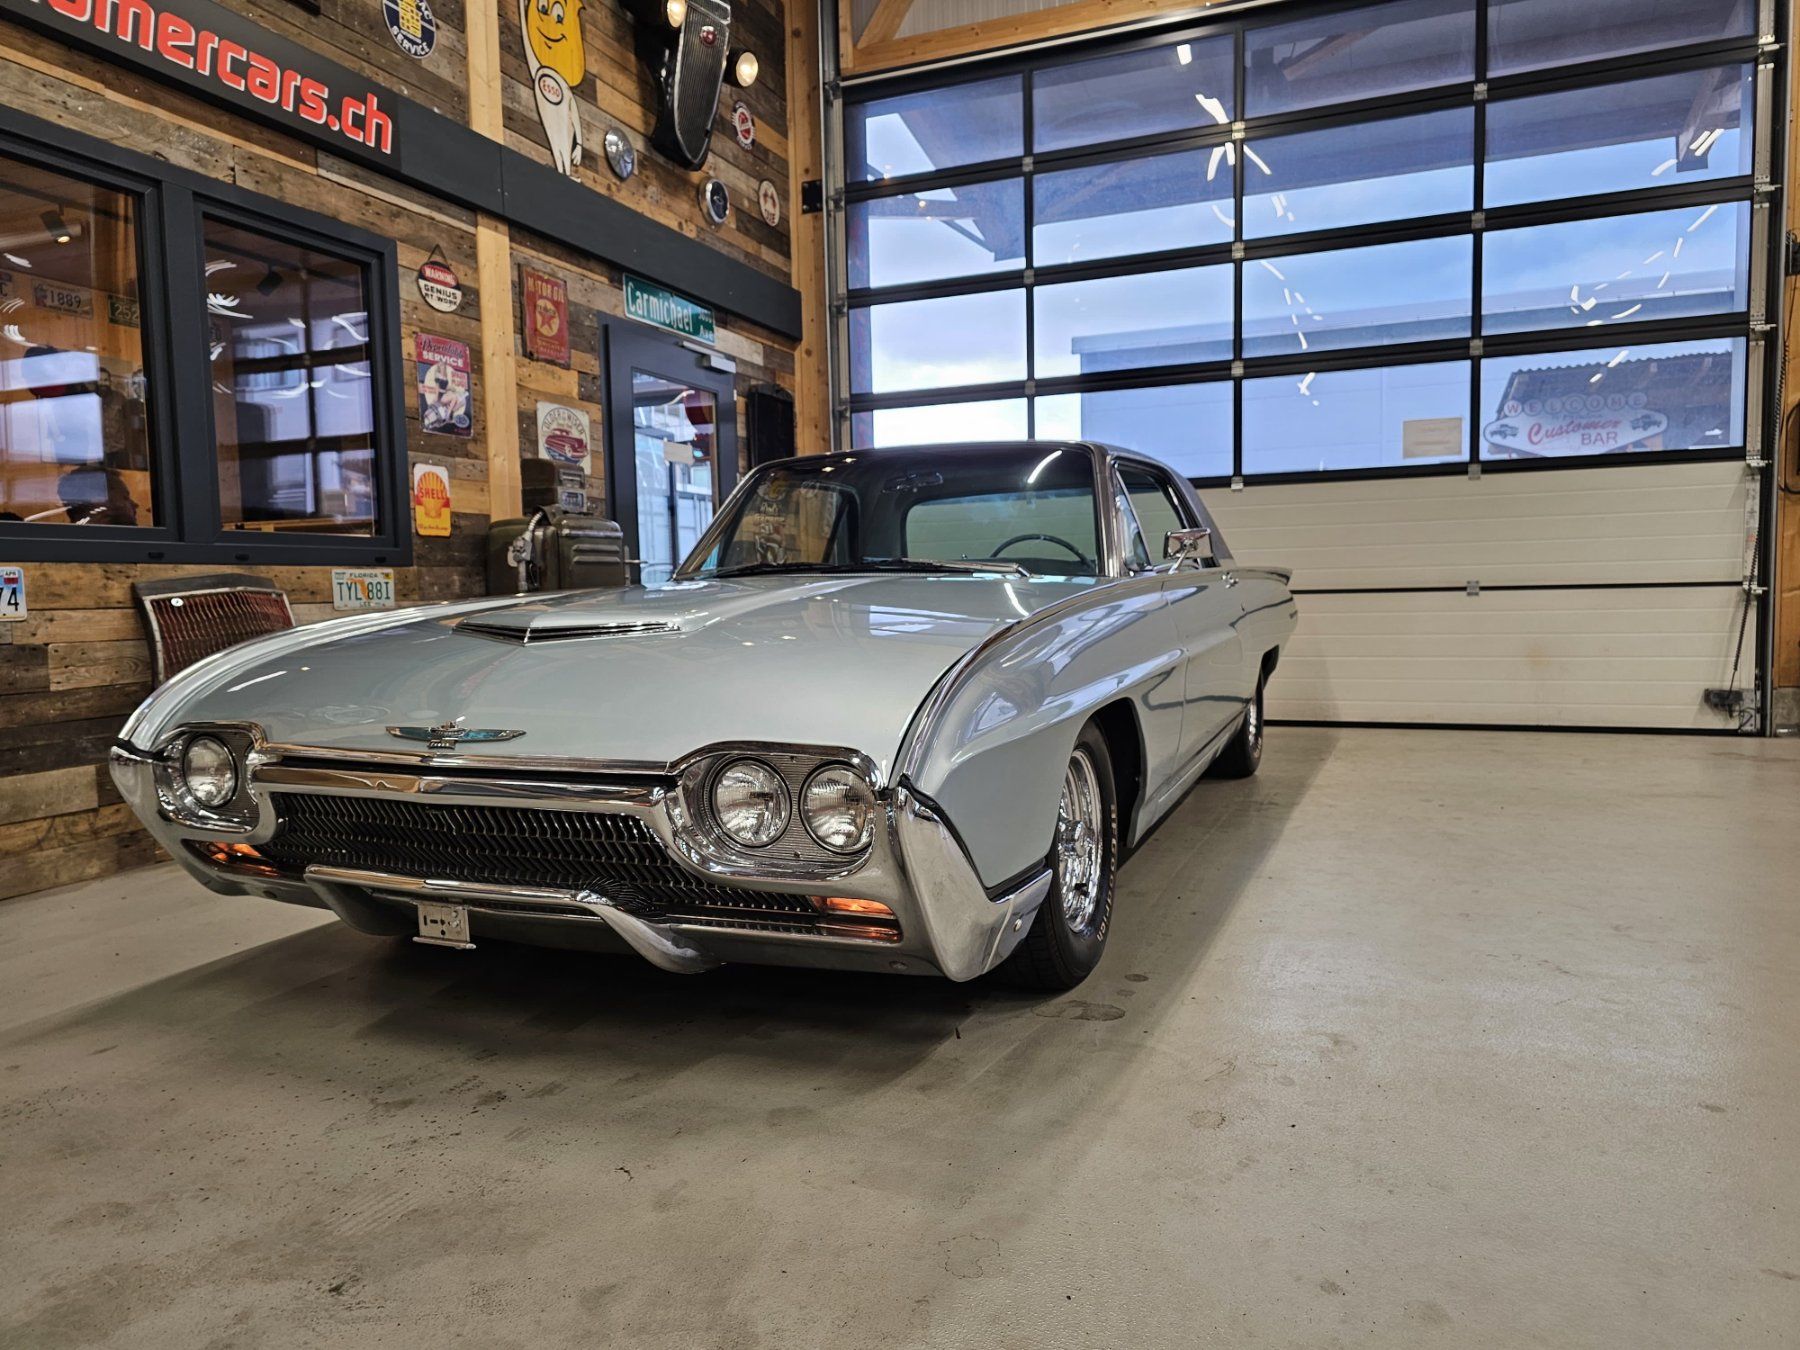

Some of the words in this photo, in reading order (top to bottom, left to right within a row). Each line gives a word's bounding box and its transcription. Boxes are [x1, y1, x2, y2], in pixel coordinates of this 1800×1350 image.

[391, 25, 430, 55] SERVICE
[424, 265, 457, 287] WARNING
[49, 289, 82, 309] 1889
[424, 284, 458, 300] GENIUS
[424, 292, 434, 300] AT
[437, 296, 458, 306] WORK
[627, 281, 693, 333] Carmichael
[700, 325, 715, 342] Ave
[422, 350, 465, 368] SERVICE
[1506, 393, 1644, 415] WELCOME
[1581, 432, 1619, 446] BAR
[420, 487, 447, 500] SHELL
[337, 581, 362, 601] TYL
